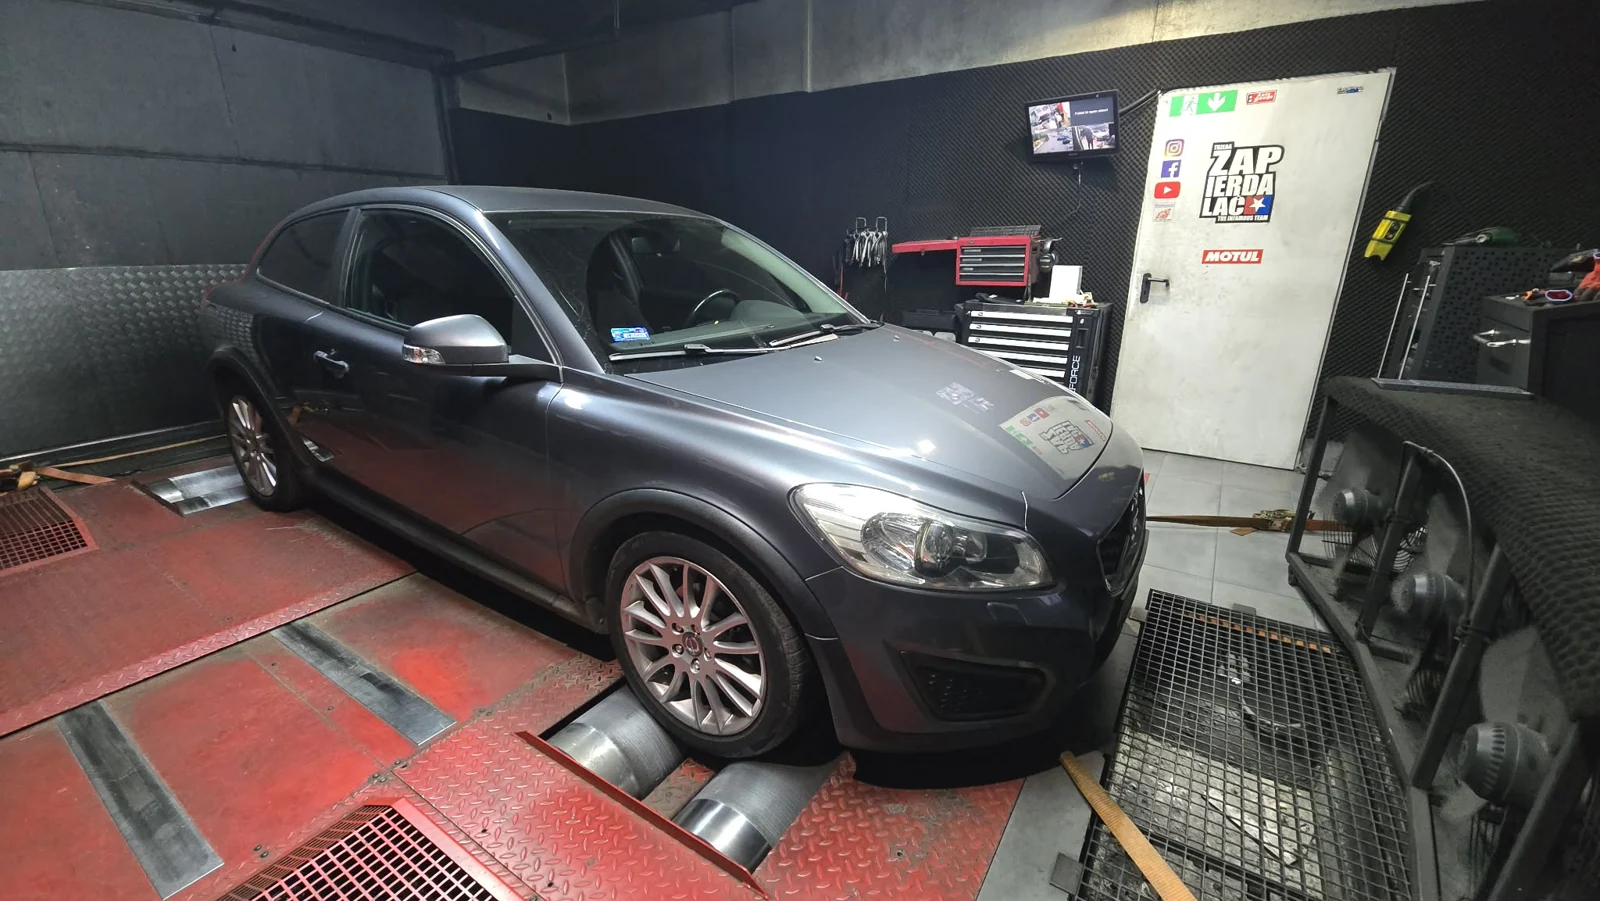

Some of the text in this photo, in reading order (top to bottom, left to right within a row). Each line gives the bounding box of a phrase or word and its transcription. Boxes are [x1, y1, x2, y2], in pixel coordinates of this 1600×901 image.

[1208, 147, 1283, 176] ZAP
[1204, 173, 1274, 198] IERDA
[1204, 251, 1260, 262] MOTUL
[1068, 355, 1081, 393] FORCE
